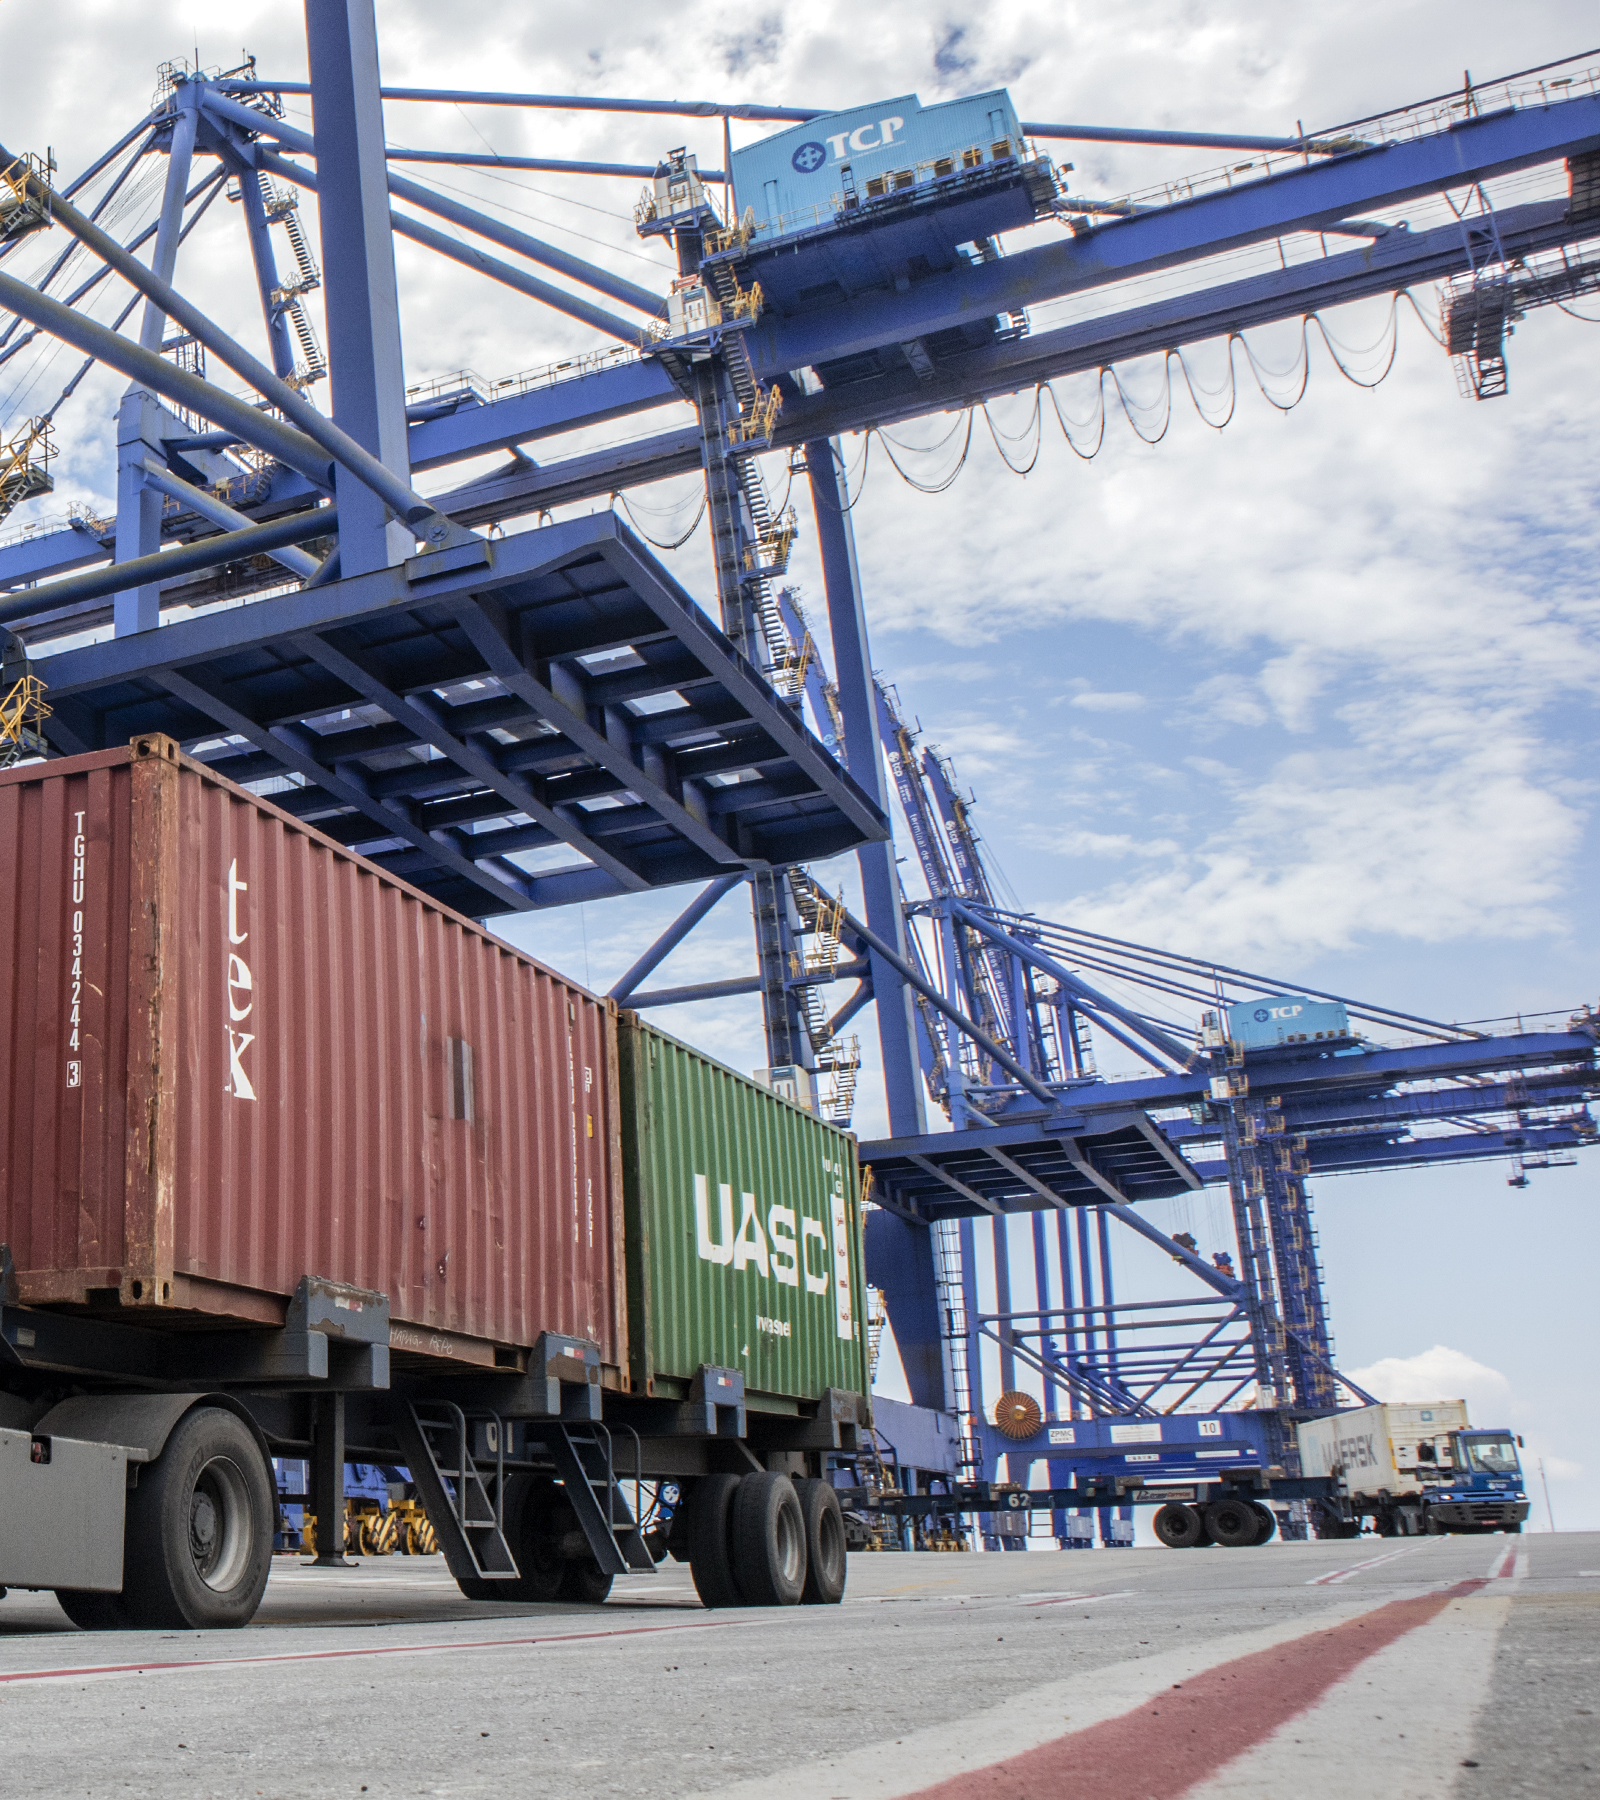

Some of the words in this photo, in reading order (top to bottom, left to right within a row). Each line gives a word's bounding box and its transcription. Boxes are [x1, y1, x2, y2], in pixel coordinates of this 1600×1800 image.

[826, 116, 905, 159] TCP
[72, 811, 86, 904] TGHU
[70, 910, 84, 1052] 034244
[224, 857, 257, 1100] tex
[1269, 1005, 1303, 1019] TCP
[694, 1173, 829, 1296] UASC
[1050, 1429, 1072, 1438] ZPMC
[1201, 1422, 1217, 1434] 10
[1008, 1493, 1030, 1508] 62
